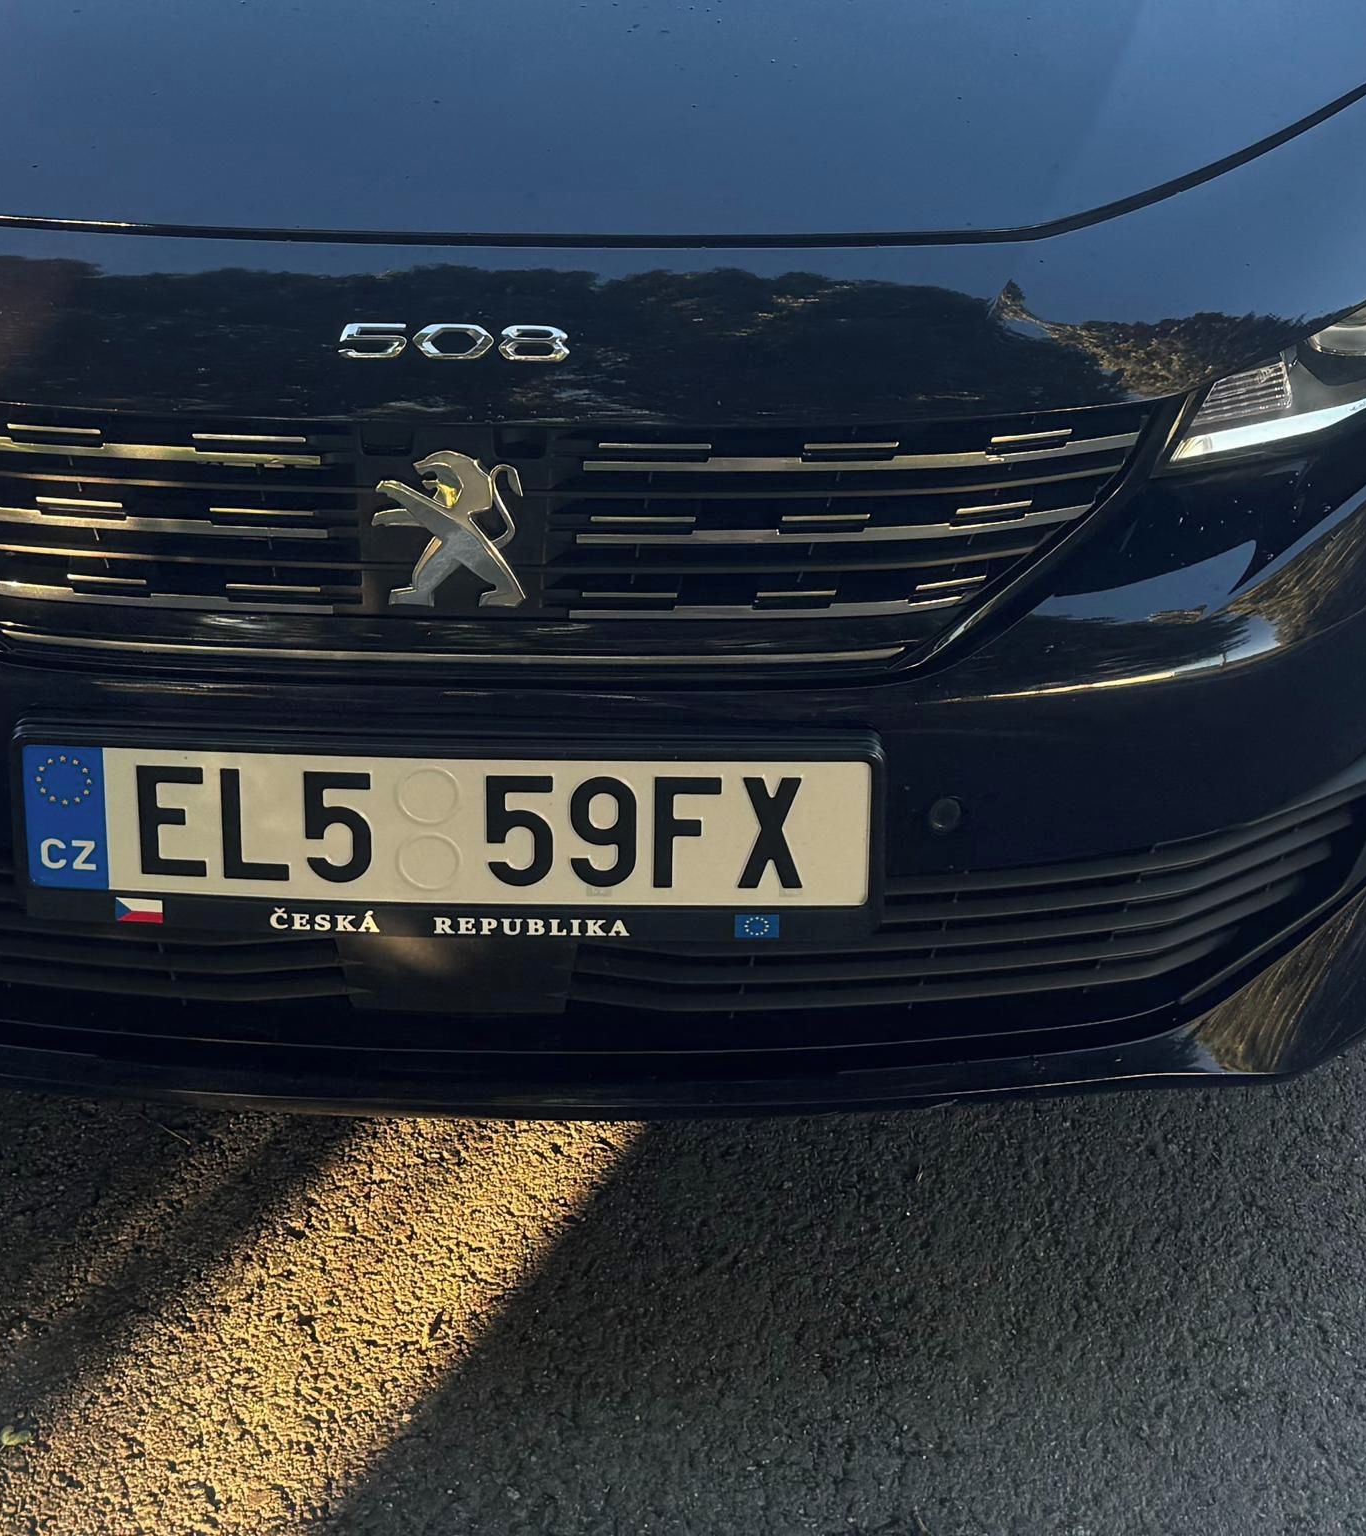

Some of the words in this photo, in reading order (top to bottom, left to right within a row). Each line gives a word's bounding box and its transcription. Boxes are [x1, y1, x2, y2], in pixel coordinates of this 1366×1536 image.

[338, 323, 571, 362] 508
[135, 764, 373, 884] EL5
[484, 774, 804, 889] 59FX
[39, 837, 98, 872] CZ
[269, 907, 381, 934] ČESKÁ
[433, 916, 631, 938] REPUBLIKA
